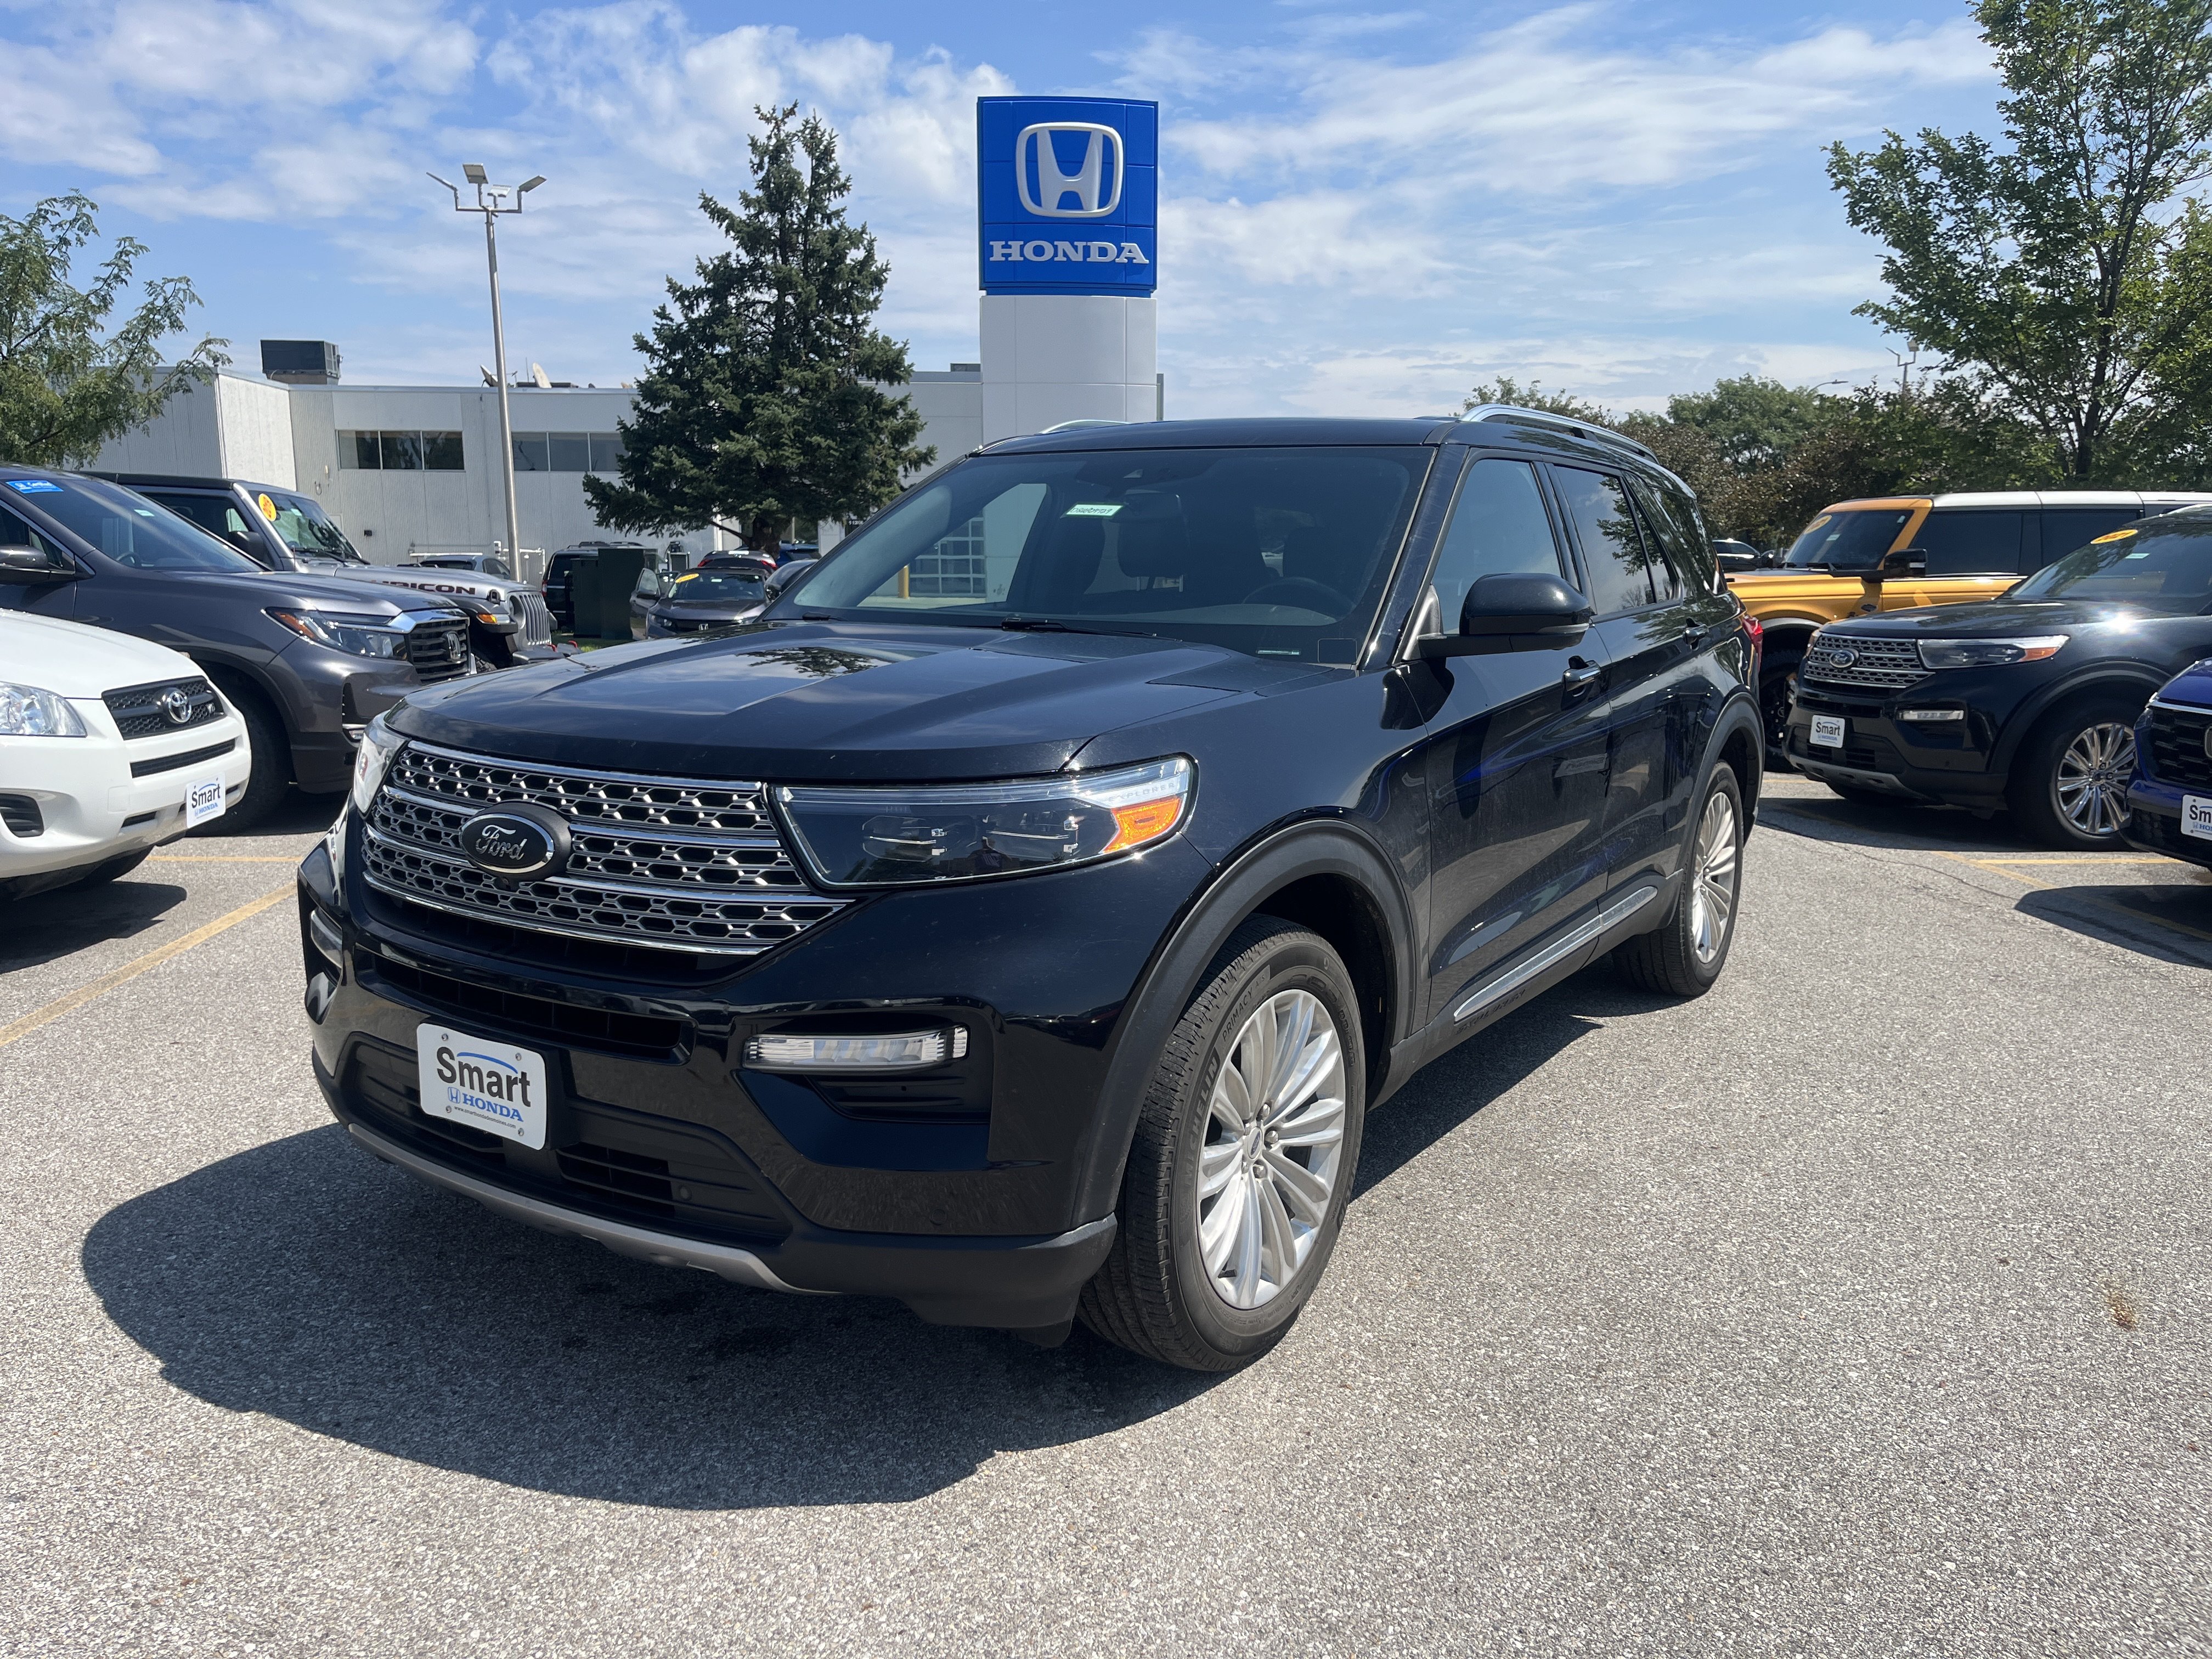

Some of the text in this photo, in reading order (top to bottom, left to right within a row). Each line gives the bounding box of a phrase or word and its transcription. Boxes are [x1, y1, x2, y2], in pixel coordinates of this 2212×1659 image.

[989, 240, 1150, 264] HONDA
[1815, 721, 1841, 736] Smart
[191, 783, 221, 809] Smart
[1108, 782, 1175, 802] EXPLORER
[199, 803, 218, 814] HONDA
[2189, 804, 2212, 823] Sm
[475, 824, 528, 861] Ford
[1222, 987, 1252, 1042] PRIMACY
[436, 1046, 532, 1108] Smart
[462, 1092, 524, 1122] HONDA
[1185, 1059, 1219, 1187] MICHELIN
